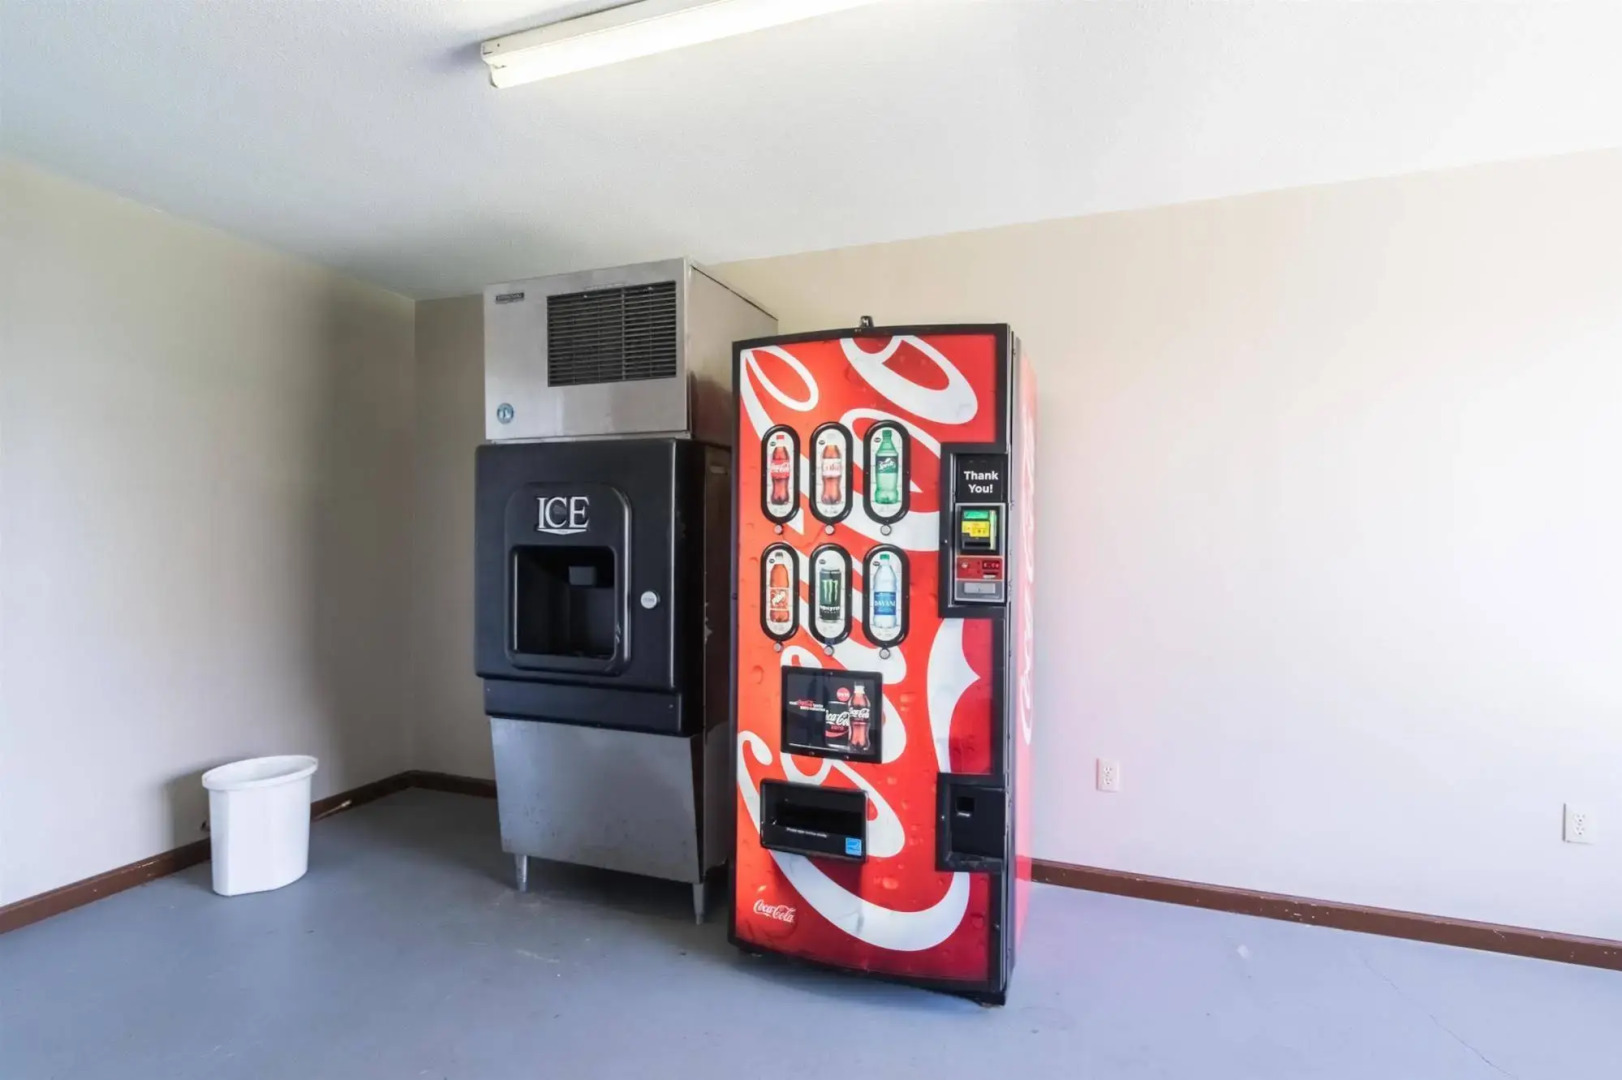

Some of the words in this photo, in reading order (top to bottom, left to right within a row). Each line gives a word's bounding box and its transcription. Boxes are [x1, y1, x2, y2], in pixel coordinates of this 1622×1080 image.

[964, 471, 999, 480] Thank
[968, 484, 994, 493] You!
[536, 496, 590, 529] ICE
[753, 899, 796, 923] Coca-Cola
